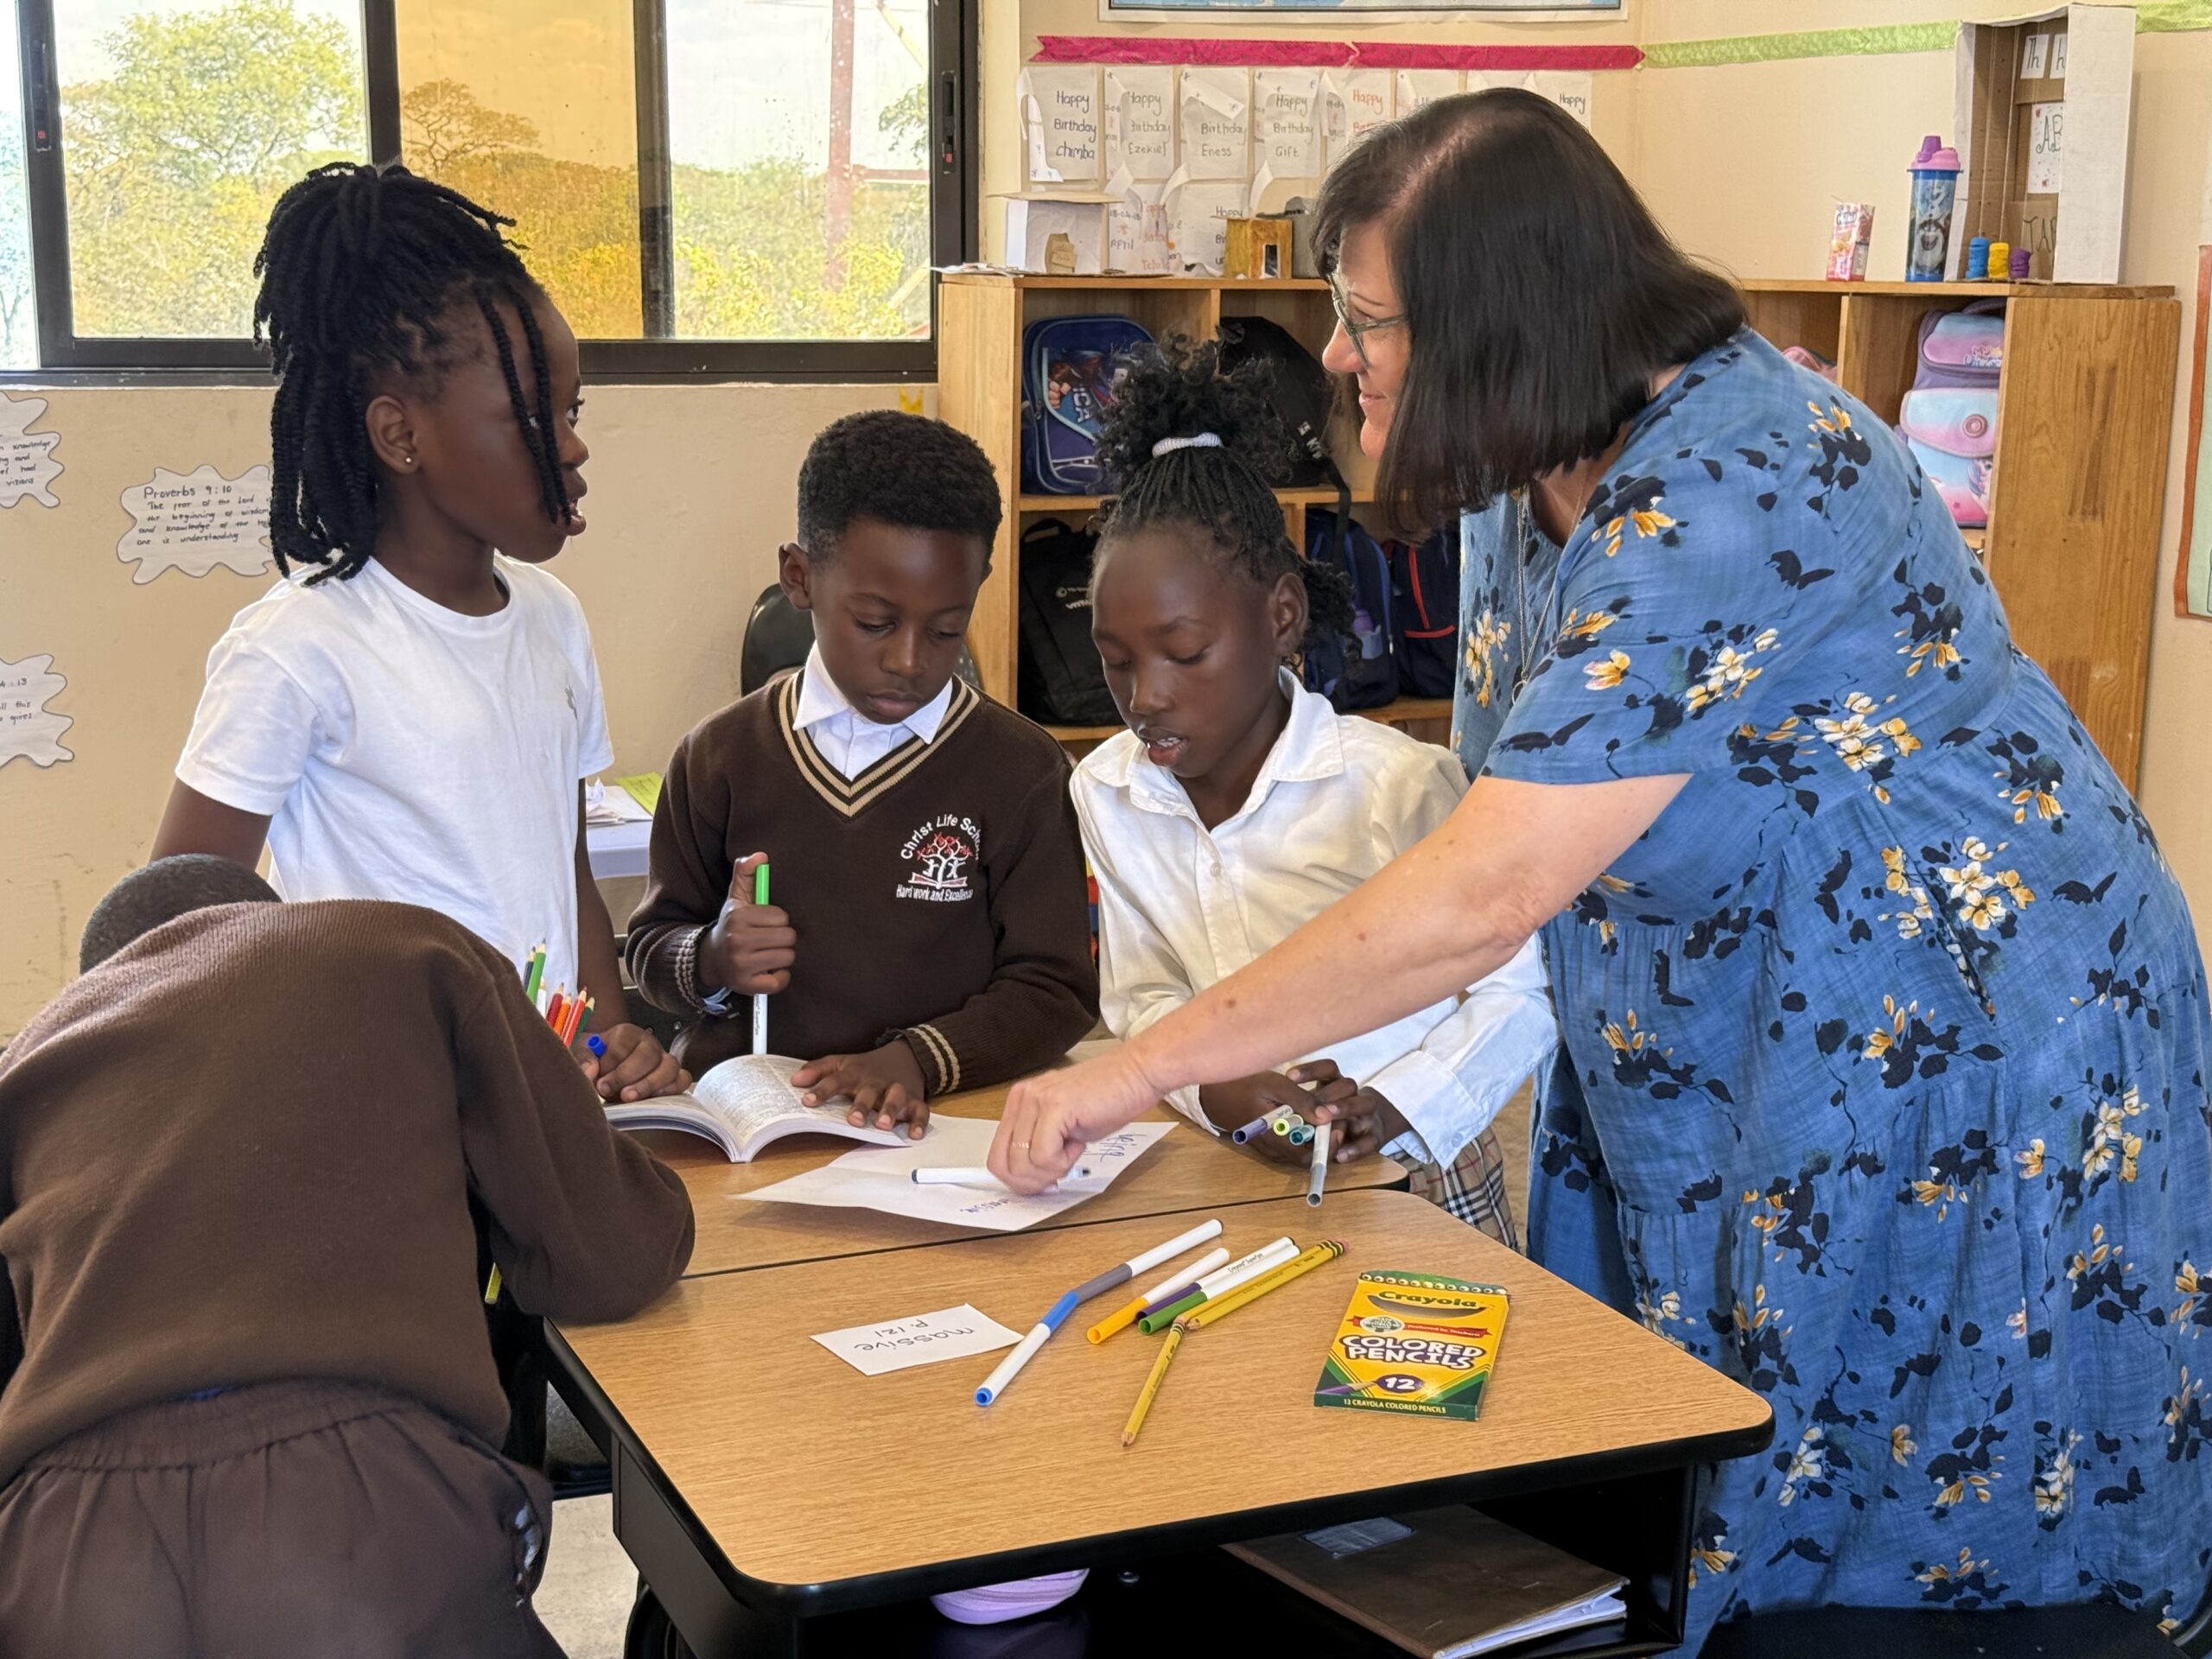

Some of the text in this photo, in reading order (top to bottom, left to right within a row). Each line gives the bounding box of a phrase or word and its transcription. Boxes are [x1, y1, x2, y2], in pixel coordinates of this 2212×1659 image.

[1056, 90, 1090, 113] Happy
[1275, 94, 1308, 118] Happy
[1352, 89, 1383, 115] Happy
[1559, 92, 1586, 115] Happy
[1054, 118, 1097, 143] Birthday
[1201, 123, 1247, 146] Birthday
[1273, 122, 1314, 145] Birthday
[1275, 145, 1300, 157] Gift
[15, 452, 30, 461] and
[143, 485, 196, 499] Proverbs
[147, 501, 164, 510] The
[238, 493, 255, 505] Lord
[172, 510, 215, 524] beginning
[138, 525, 156, 534] and
[166, 521, 210, 533] knowledge
[181, 531, 239, 543] understanding
[900, 822, 933, 860] Christ
[936, 814, 958, 828] Life
[930, 888, 944, 902] and
[1379, 1291, 1478, 1307] Crayola
[1341, 1336, 1484, 1357] COLORED
[1348, 1347, 1475, 1370] PENCILS
[1384, 1376, 1416, 1390] 12
[1352, 1399, 1384, 1408] CRAYOLA
[1385, 1402, 1418, 1411] COLORED
[1418, 1405, 1446, 1414] PENCILS
